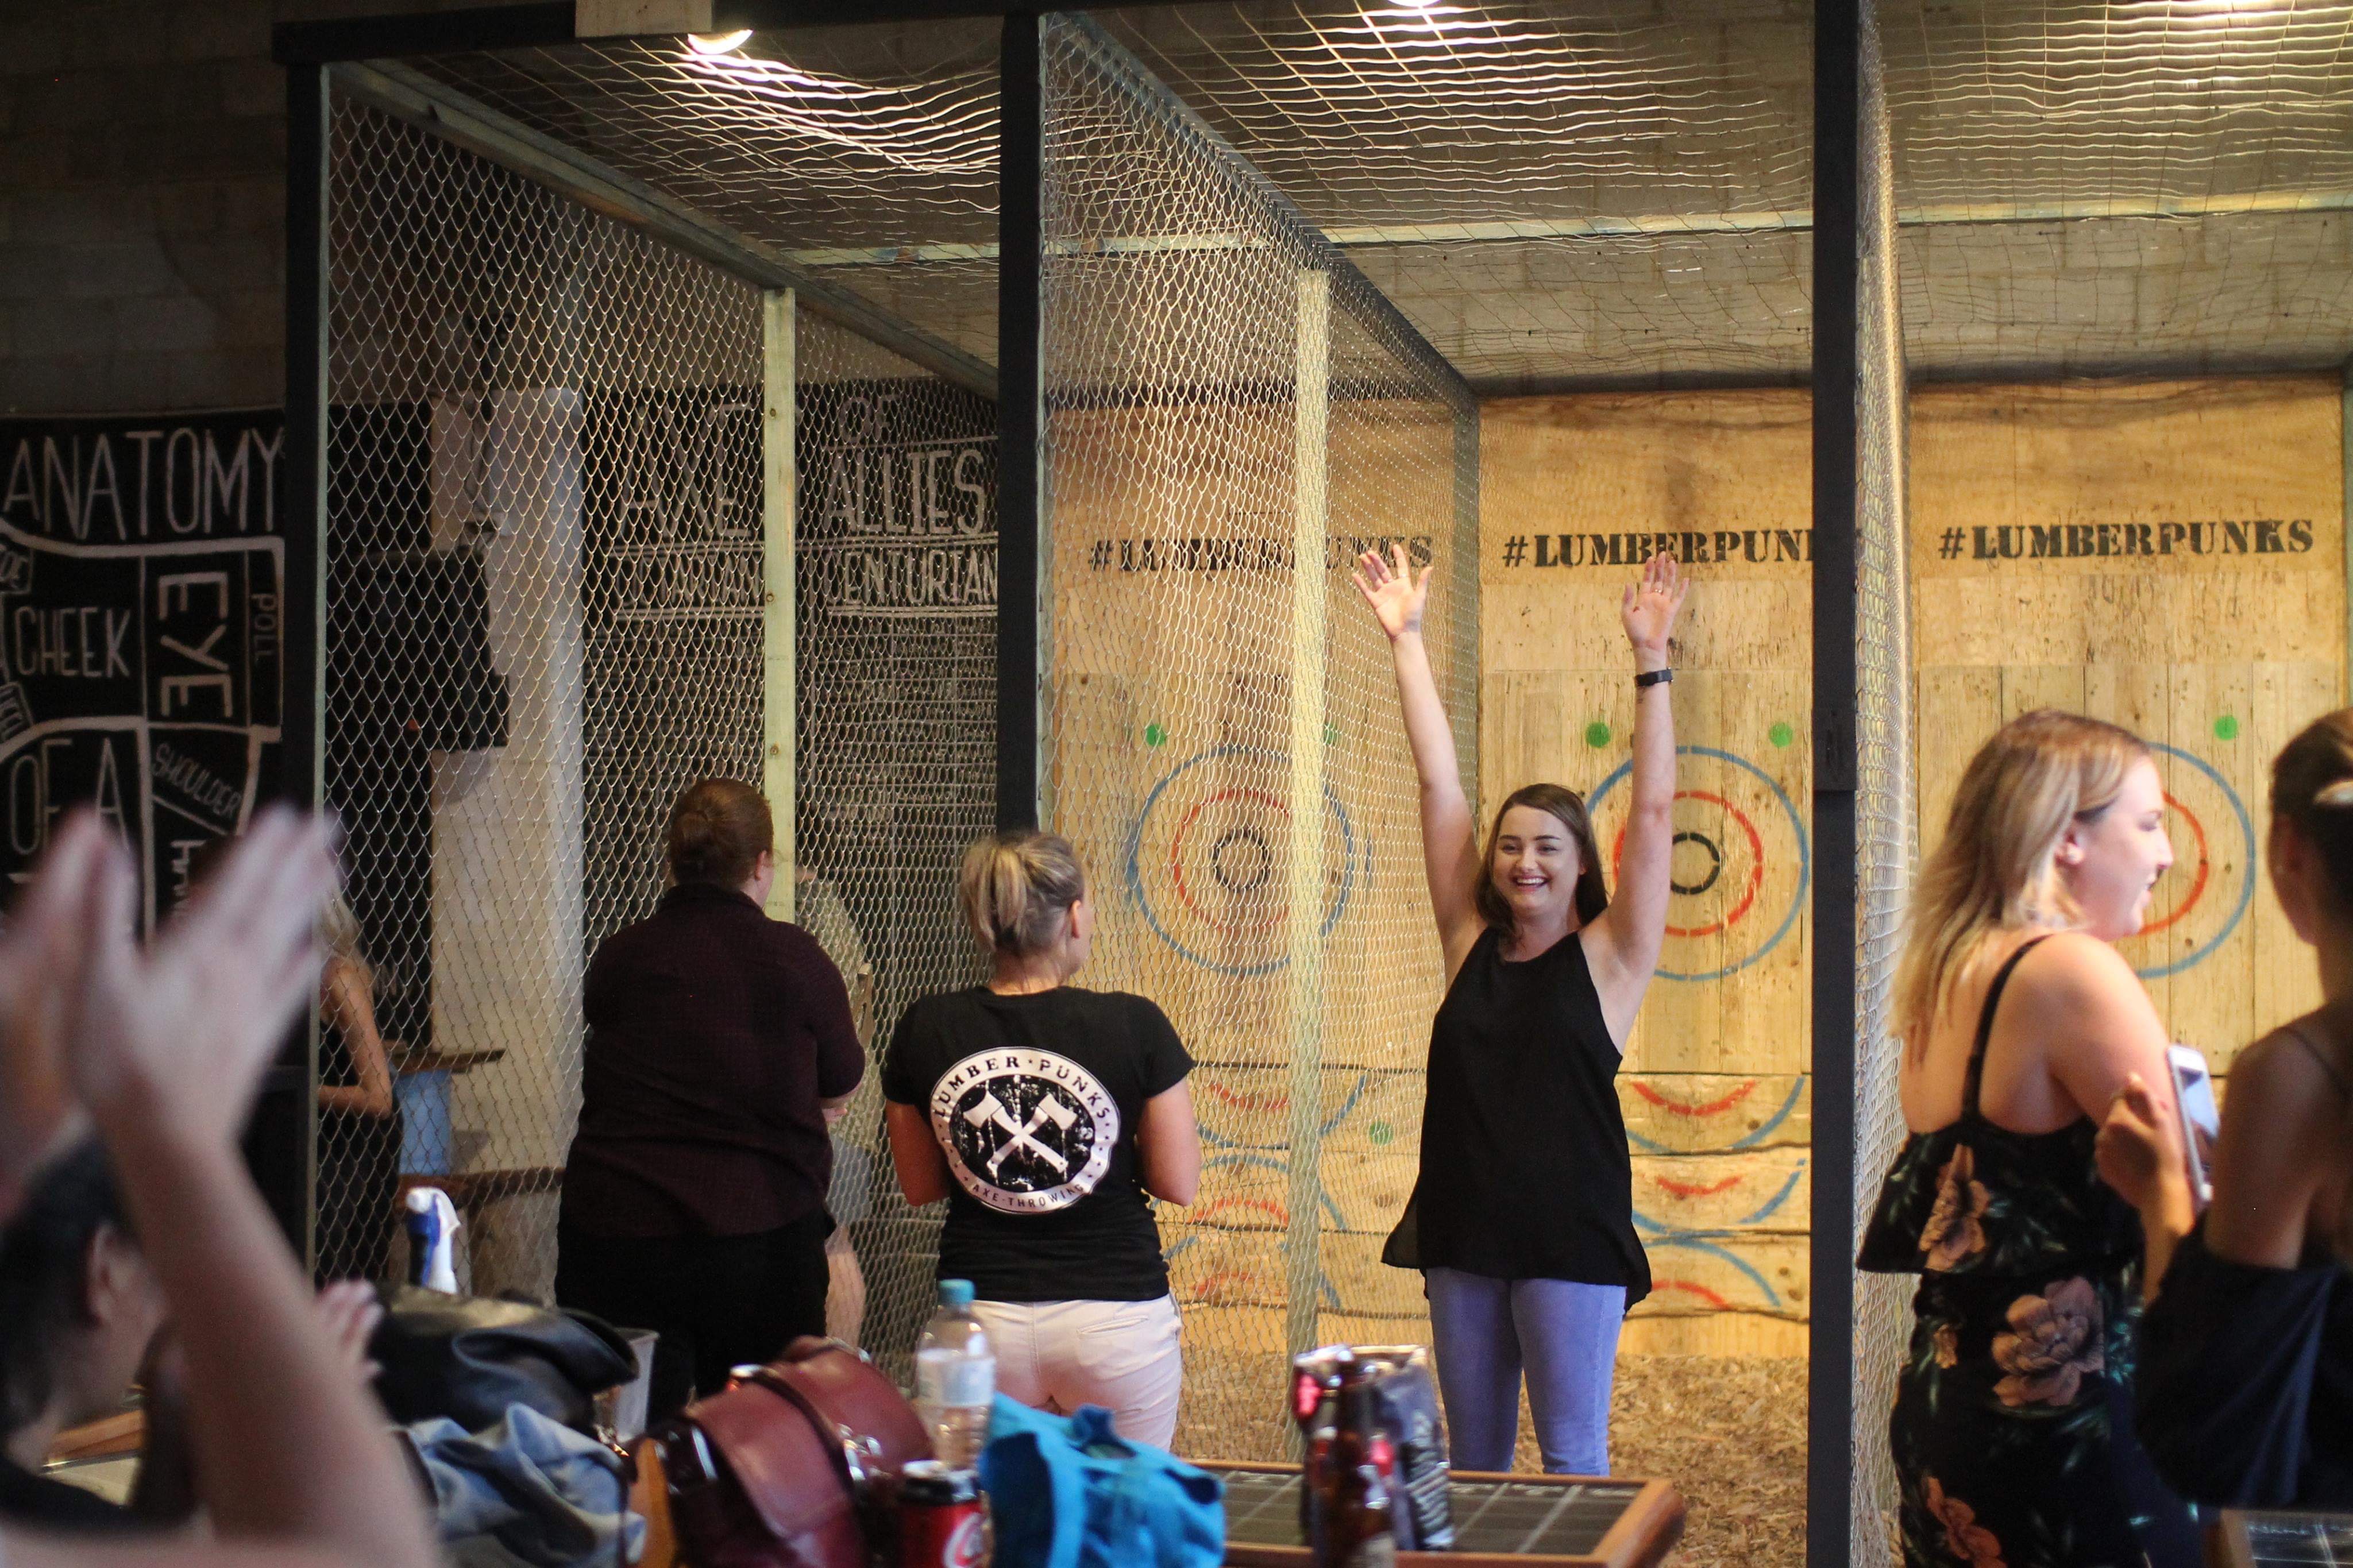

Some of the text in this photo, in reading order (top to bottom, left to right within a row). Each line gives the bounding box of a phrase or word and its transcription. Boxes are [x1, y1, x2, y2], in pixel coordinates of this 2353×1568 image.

[2, 426, 286, 540] ANATOMY
[819, 449, 985, 534] ALLIES
[1088, 535, 1433, 572] #LUMBERUNKS
[1937, 519, 2314, 561] #LUMBERPUNKS
[14, 606, 130, 678] CHEEK
[158, 571, 233, 717] EYE
[934, 1055, 1111, 1119] LUMBER PUNKS
